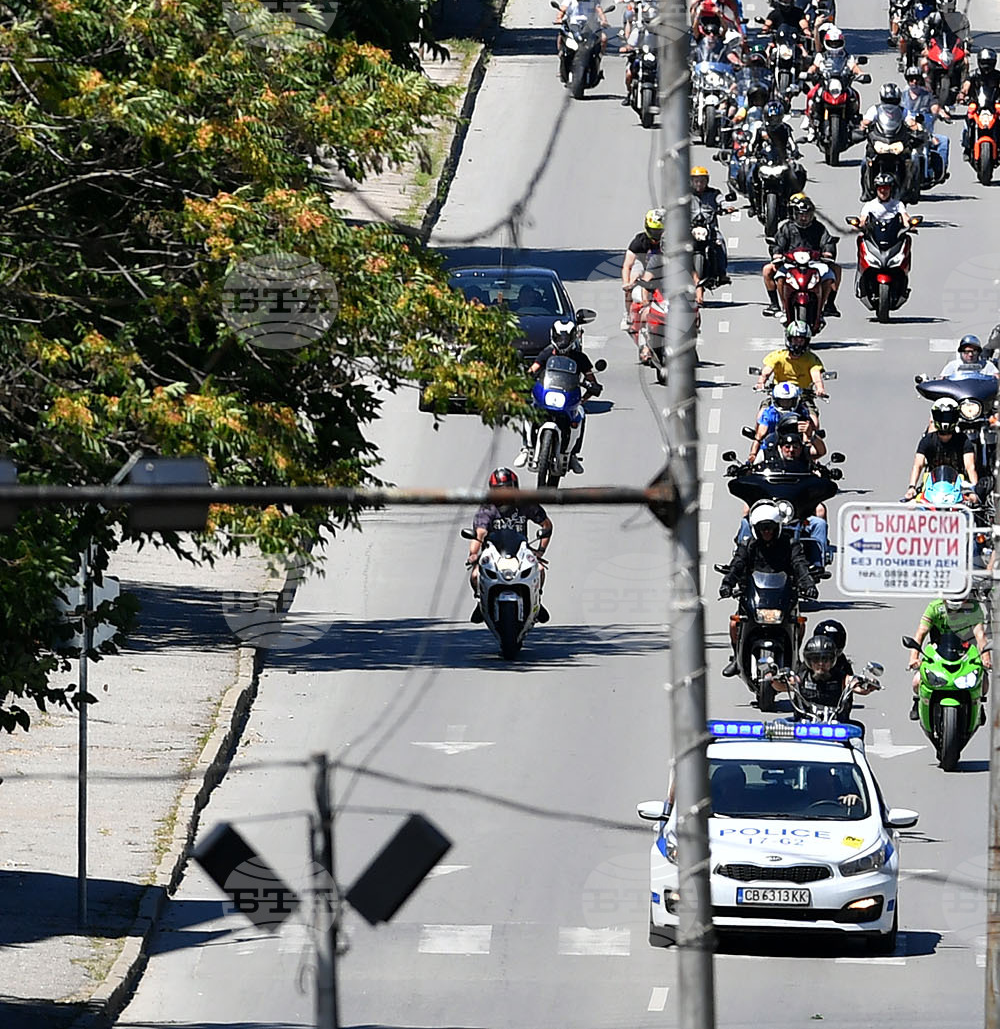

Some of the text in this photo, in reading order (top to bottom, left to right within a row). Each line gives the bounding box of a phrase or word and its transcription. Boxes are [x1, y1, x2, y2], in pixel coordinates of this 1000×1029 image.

[850, 513, 959, 534] СТЪКЛАРСКИ
[884, 536, 959, 557] УСЛУГИ
[851, 557, 959, 568] БЕЗ ПОЧИВЕН ДЕН
[720, 827, 831, 840] POLICE
